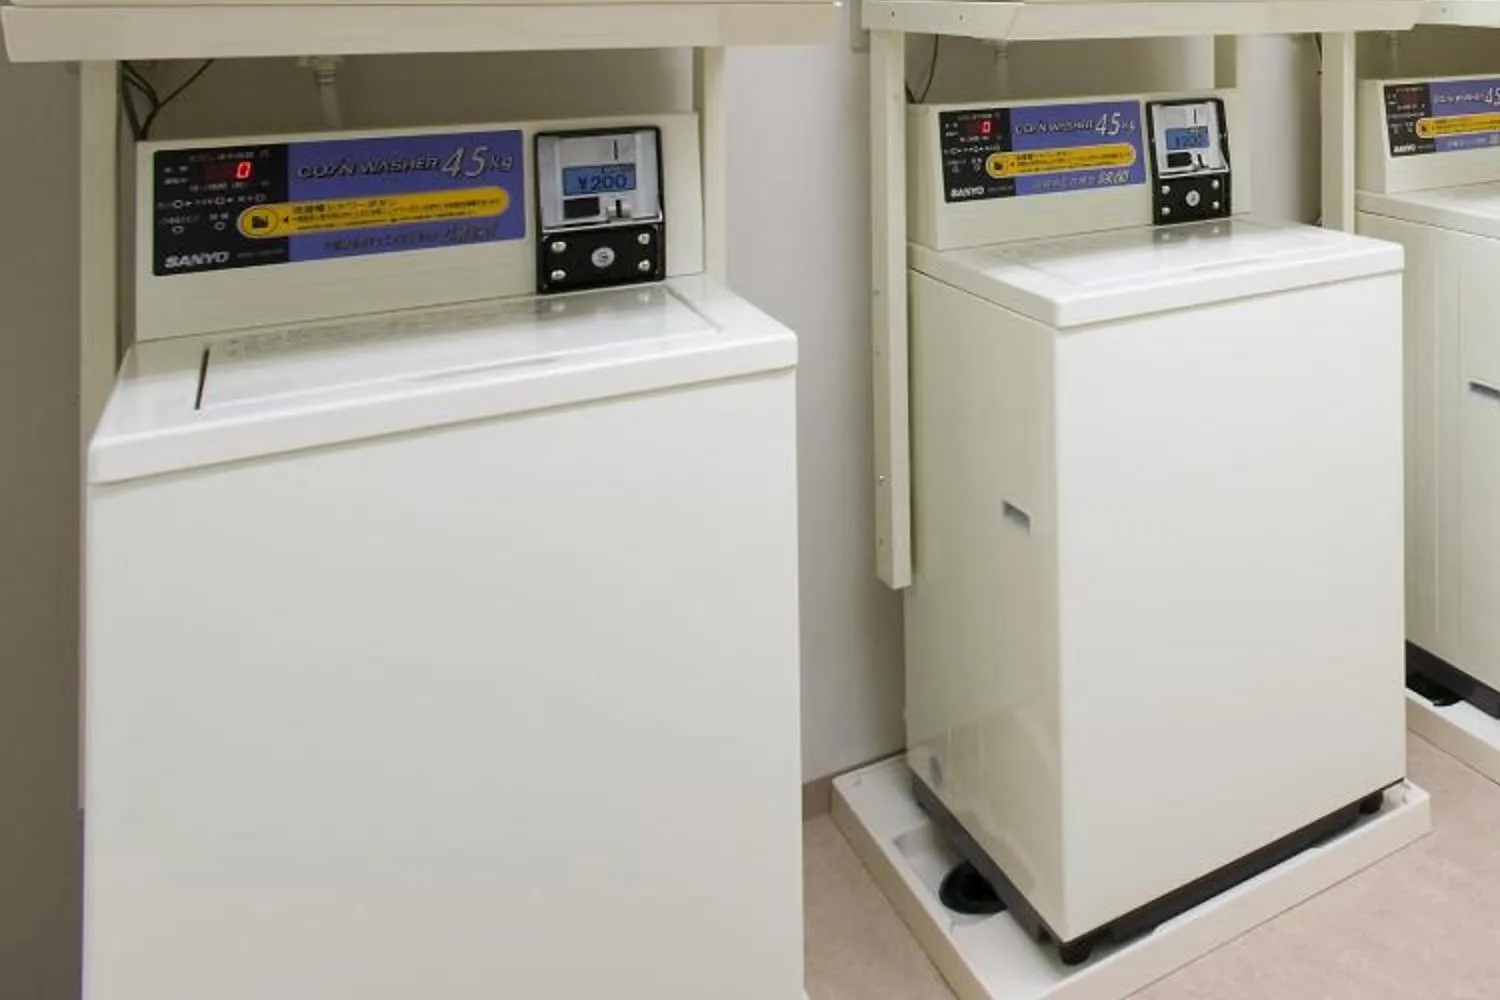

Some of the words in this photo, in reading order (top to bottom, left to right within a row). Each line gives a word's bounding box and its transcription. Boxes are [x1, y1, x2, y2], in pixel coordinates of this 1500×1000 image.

[235, 160, 251, 179] 0
[361, 156, 438, 175] WASHER
[164, 251, 230, 268] SANYO
